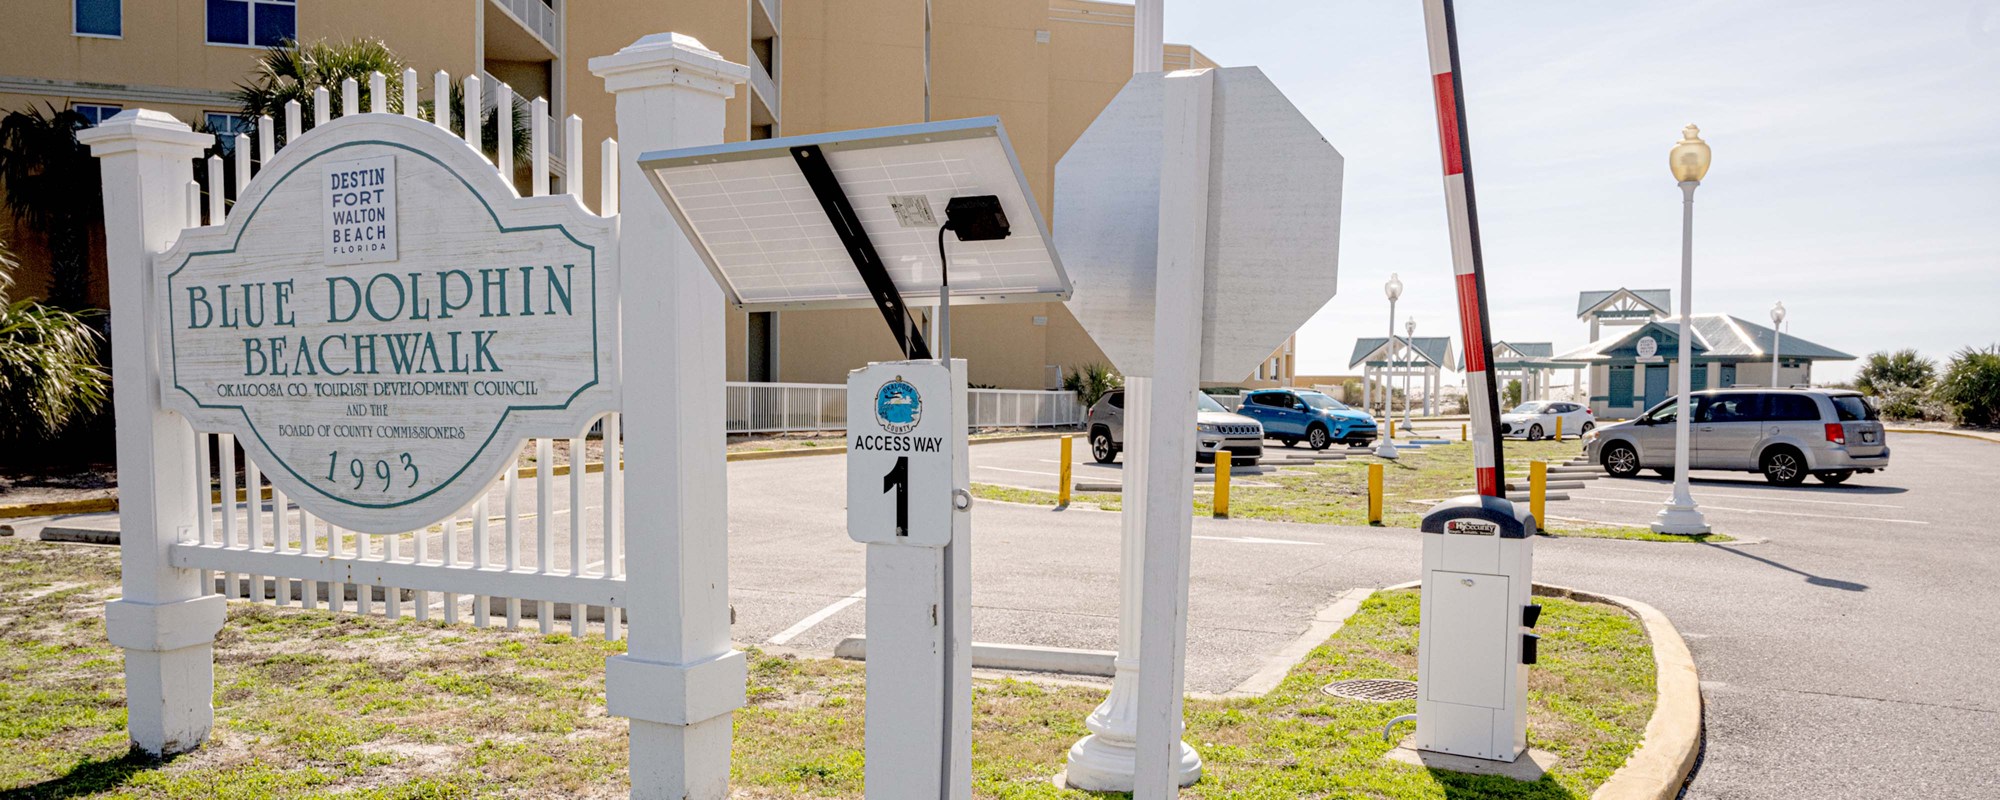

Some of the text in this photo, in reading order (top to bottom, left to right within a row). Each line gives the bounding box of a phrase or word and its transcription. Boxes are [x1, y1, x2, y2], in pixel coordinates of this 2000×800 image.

[331, 168, 385, 190] DESTIN
[332, 189, 385, 207] FORT
[333, 207, 386, 225] WALTON
[333, 225, 386, 243] BEACH
[333, 243, 386, 254] FLORIDA
[186, 264, 575, 329] BLUE DOLPHIN
[242, 330, 503, 377] BEACHWALK
[217, 383, 284, 397] OKALOOSA
[314, 382, 368, 397] TOURIST
[373, 380, 469, 396] DEVELOPMENT
[473, 380, 538, 396] COUNCIL
[346, 404, 389, 416] AND THE
[278, 424, 466, 440] BOARD OF COUNTY COMMISSIONERS
[886, 423, 911, 433] COUNTY
[855, 435, 943, 453] ACCESS WAY
[325, 450, 419, 493] 1993
[883, 456, 909, 537] 1
[1455, 521, 1496, 532] HySecurity
